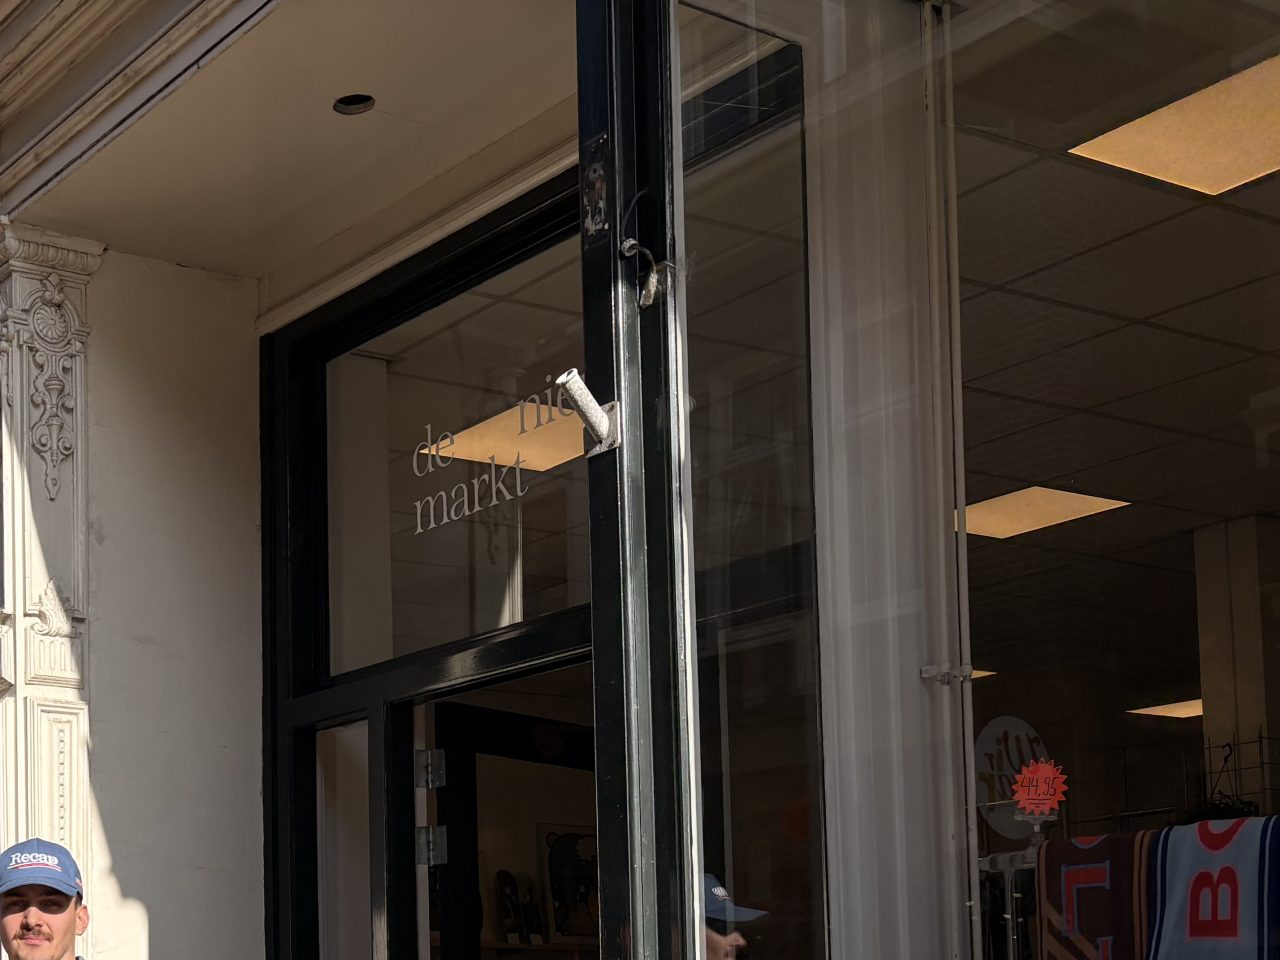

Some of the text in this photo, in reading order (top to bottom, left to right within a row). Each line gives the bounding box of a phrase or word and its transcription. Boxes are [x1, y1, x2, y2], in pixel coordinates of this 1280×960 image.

[412, 374, 585, 478] de nie
[413, 450, 529, 535] markt
[1020, 774, 1058, 797] 44,95
[9, 852, 59, 866] Recap
